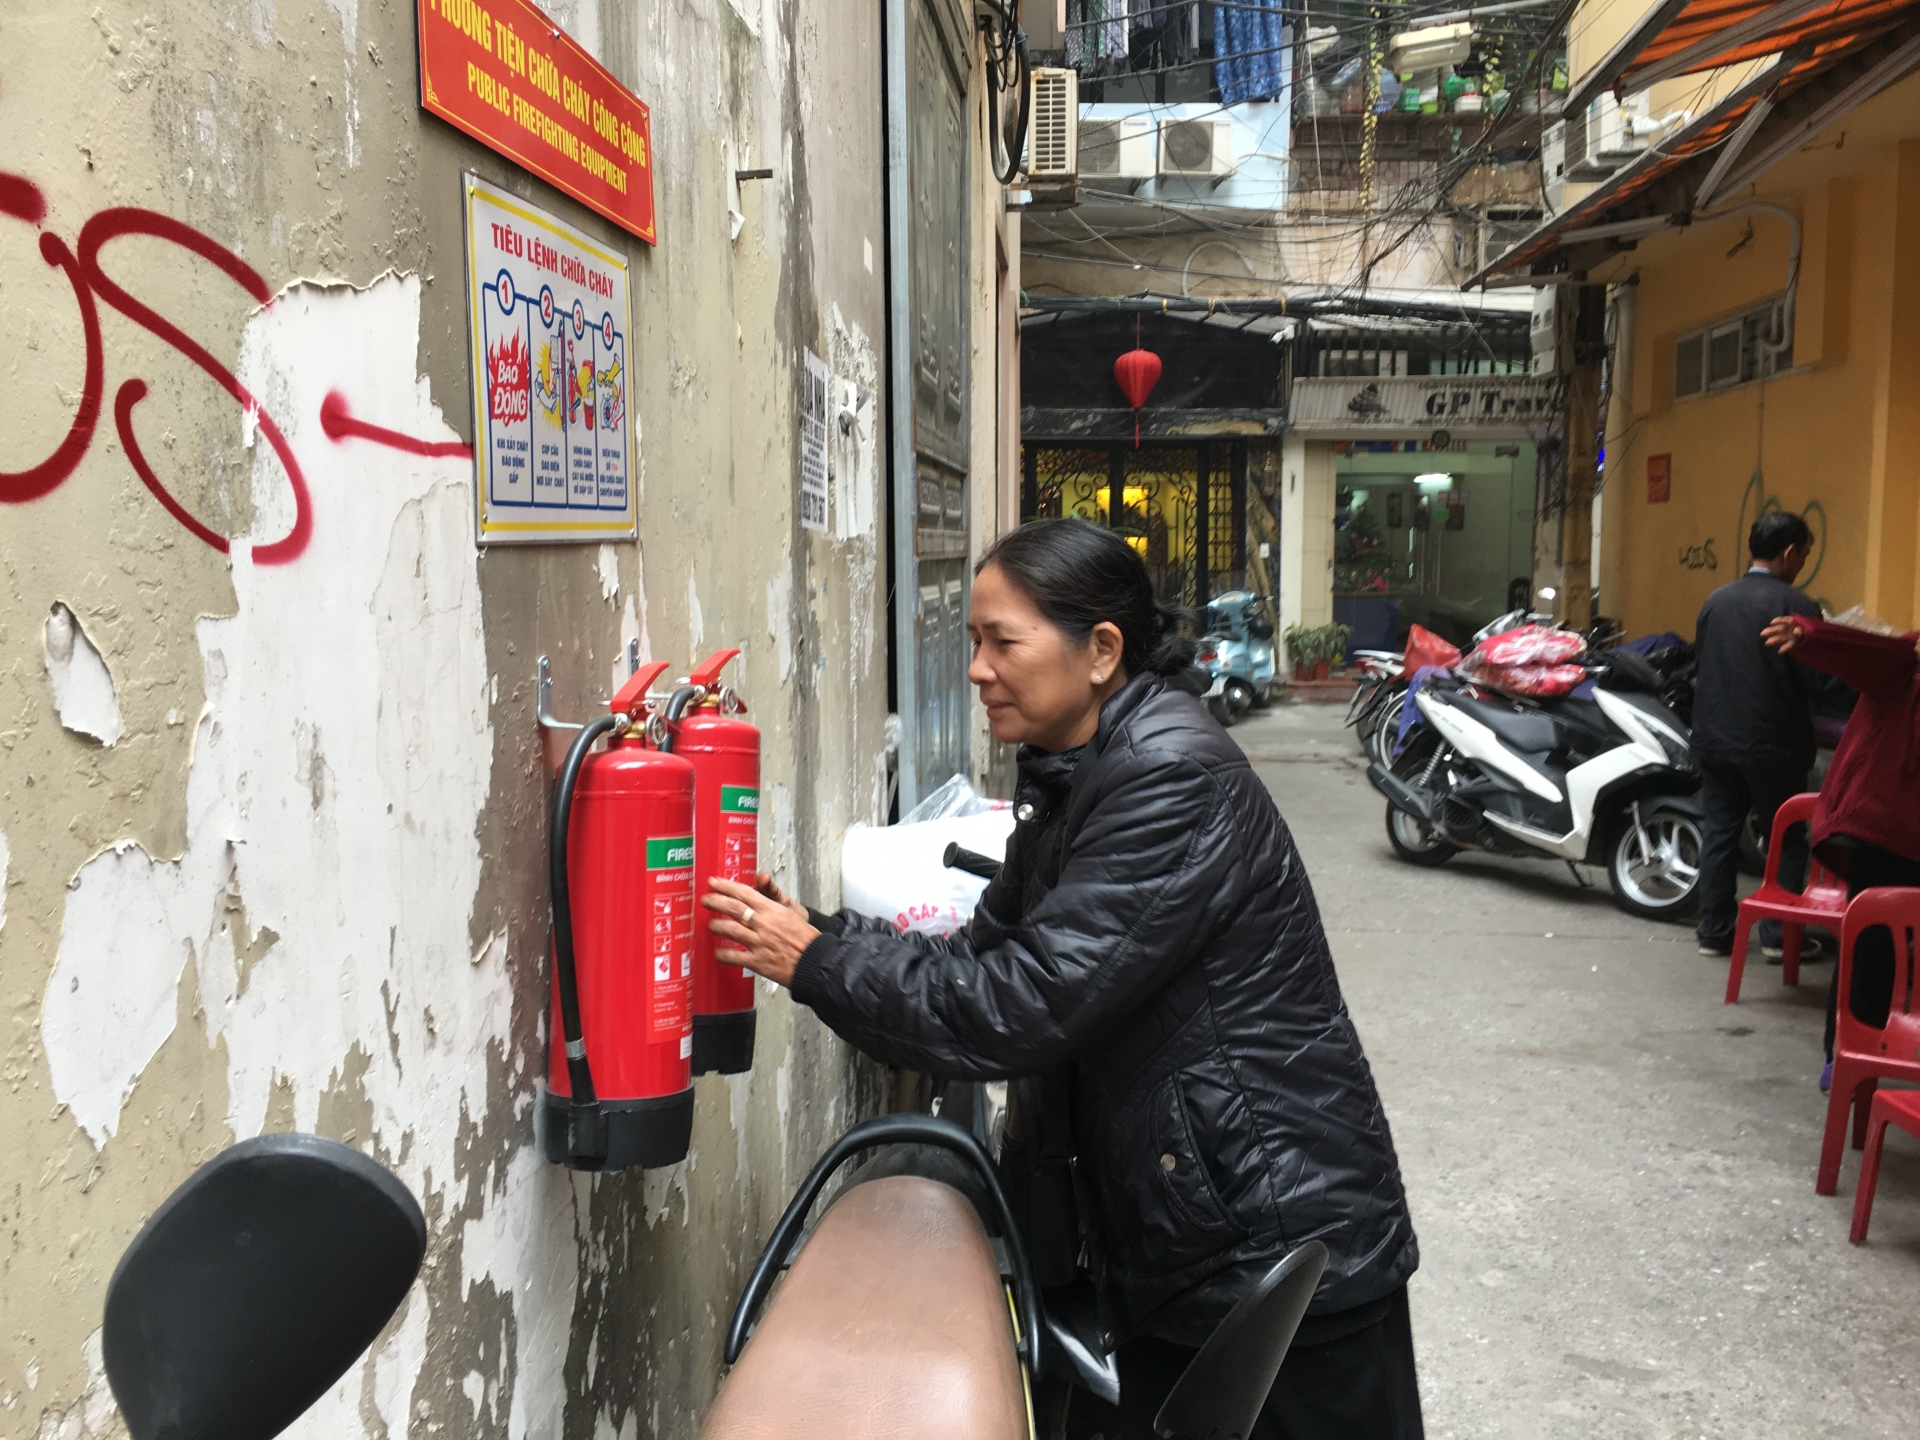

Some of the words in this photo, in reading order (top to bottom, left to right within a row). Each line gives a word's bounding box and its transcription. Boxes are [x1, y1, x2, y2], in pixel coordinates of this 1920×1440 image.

[494, 19, 526, 78] TIỆN
[528, 47, 561, 104] CHỮA
[562, 75, 591, 126] CHÁY
[592, 98, 619, 149] CÔNG
[620, 121, 646, 168] CỘNG
[467, 61, 511, 117] PUBLIC
[513, 93, 579, 163] FIREFIGHTING
[580, 141, 627, 195] EQUIPMENT
[491, 222, 523, 258] TIÊU
[527, 237, 558, 273] LỆNH
[560, 254, 586, 287] CHỮA
[588, 269, 614, 299] CHÁY
[501, 280, 509, 304] 1
[543, 294, 551, 319] 2
[575, 309, 582, 333] 3
[604, 321, 611, 342] 4
[498, 358, 519, 384] BÁO
[494, 386, 527, 420] ĐỘNG
[1426, 391, 1471, 415] GP
